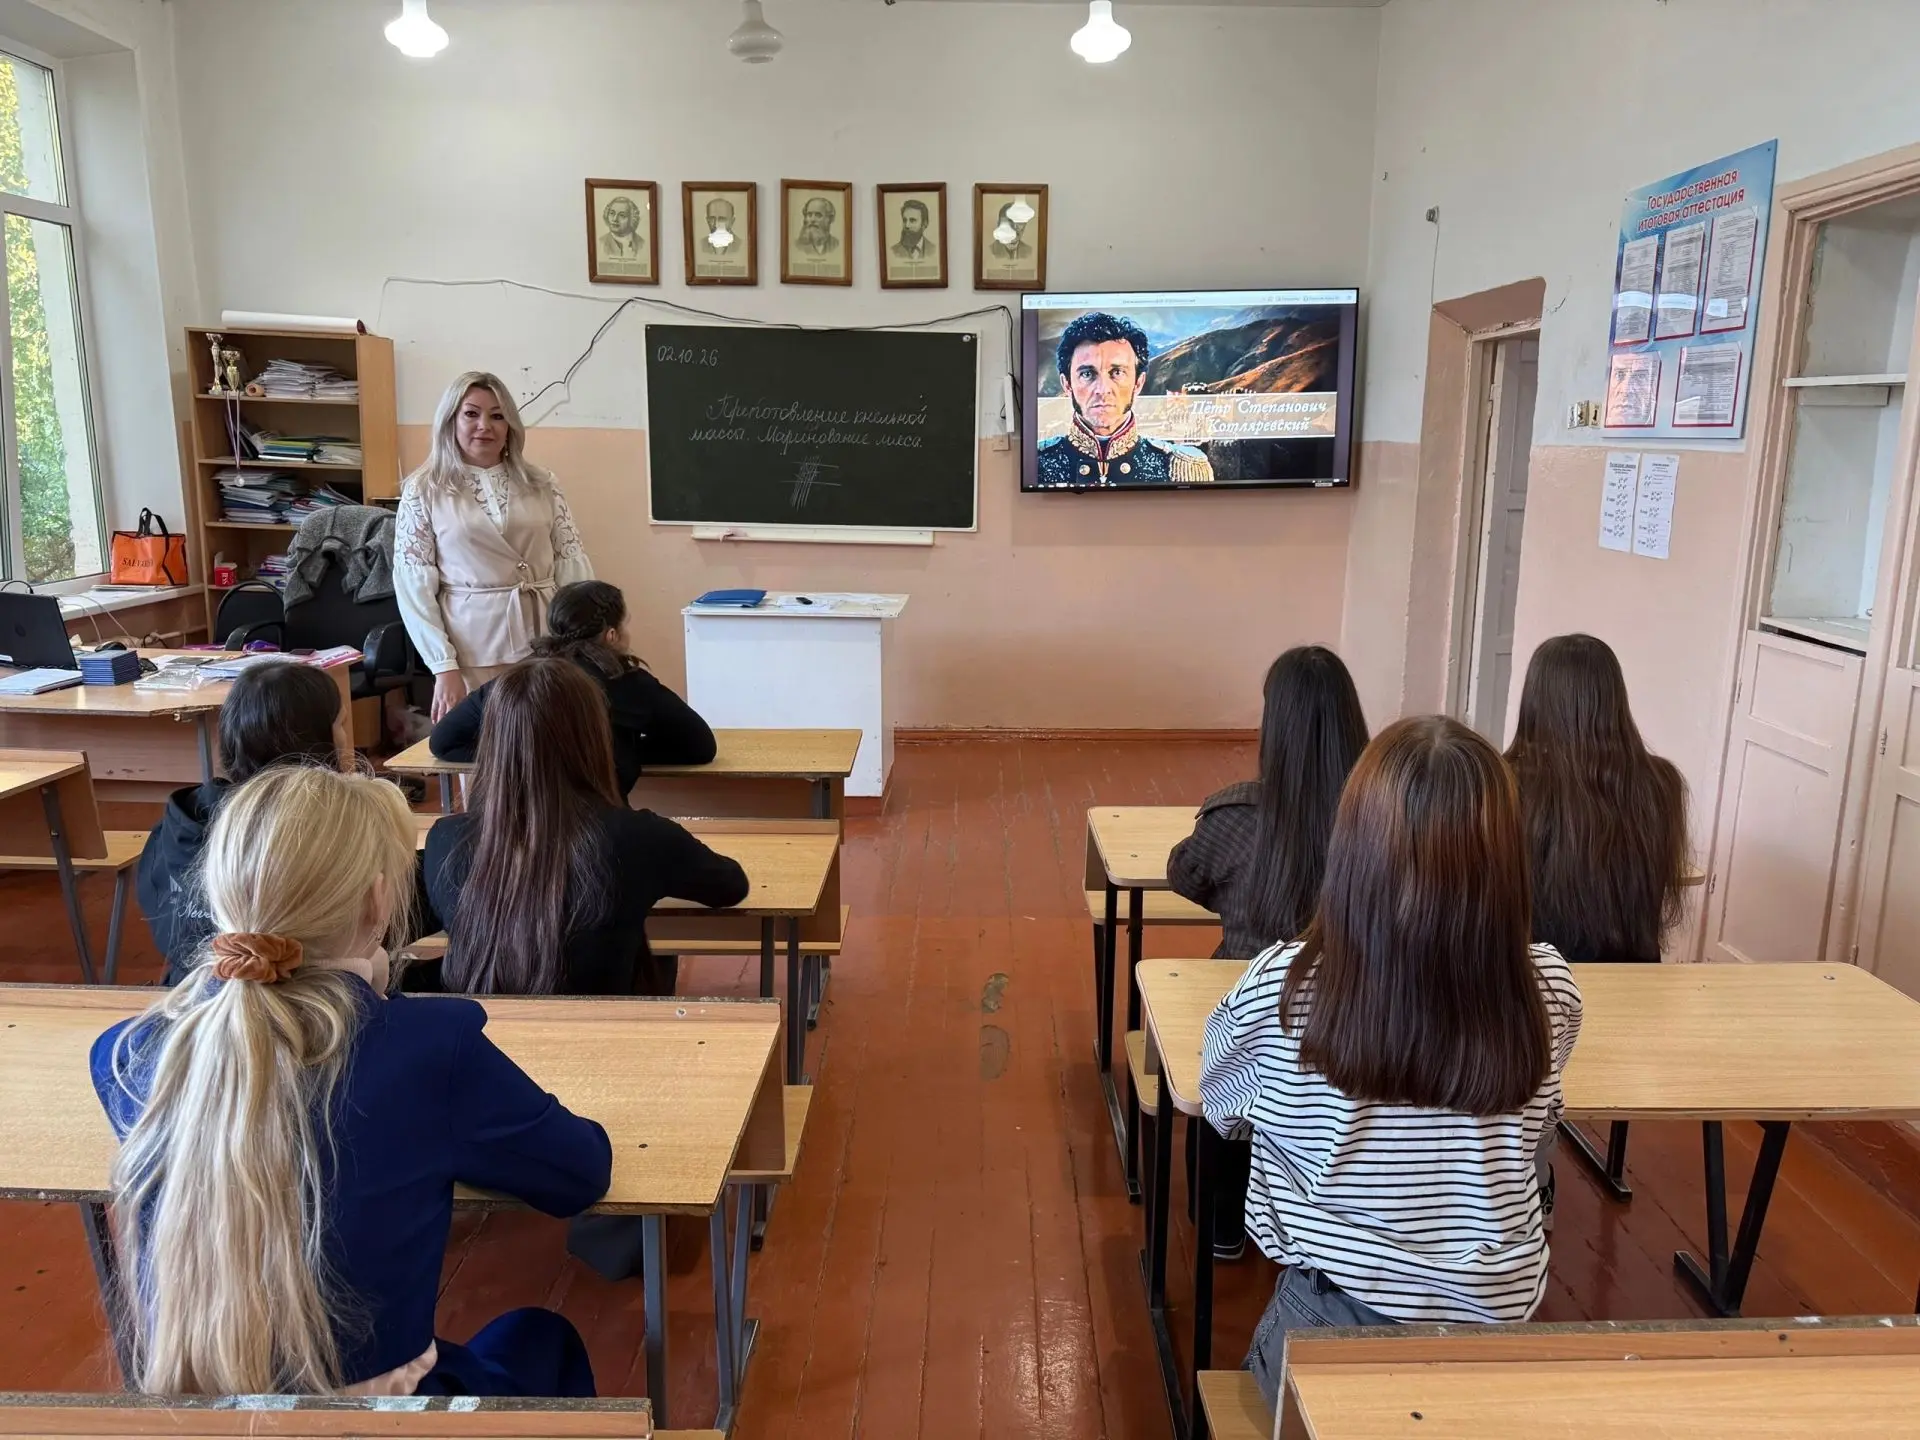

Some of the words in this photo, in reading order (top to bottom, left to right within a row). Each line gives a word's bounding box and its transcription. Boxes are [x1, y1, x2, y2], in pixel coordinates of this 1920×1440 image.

[1647, 170, 1738, 209] Государственная
[1637, 209, 1681, 232] итоговая
[1682, 188, 1745, 219] аттестация
[1190, 399, 1231, 415] Пётр
[1236, 395, 1327, 415] Степанович
[1206, 416, 1311, 435] Котляревский
